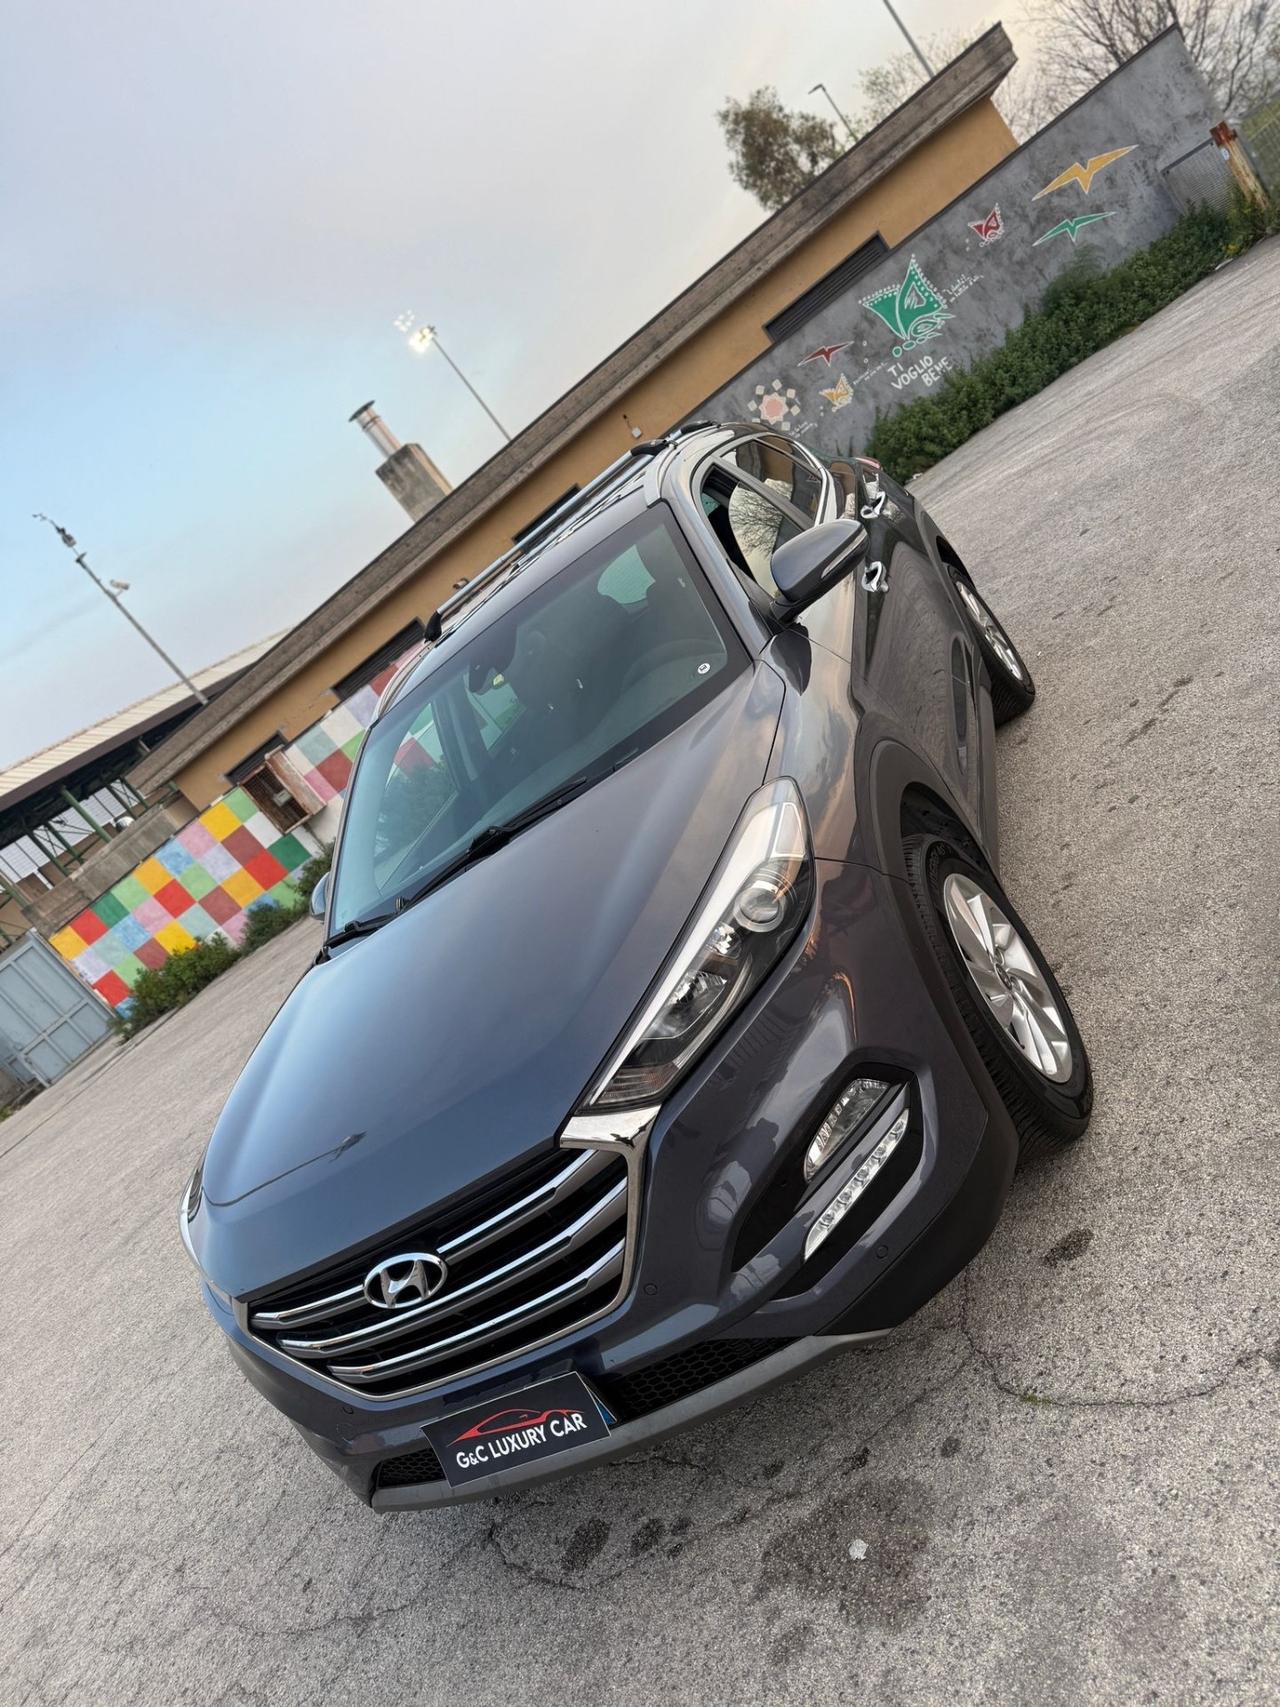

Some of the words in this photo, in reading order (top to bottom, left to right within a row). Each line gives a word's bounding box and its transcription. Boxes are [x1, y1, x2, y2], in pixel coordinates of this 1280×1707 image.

[887, 362, 904, 377] TI
[890, 355, 933, 390] VOGLIO
[456, 1445, 489, 1469] G&C
[488, 1424, 547, 1459] LUXURY
[550, 1412, 588, 1437] CAR
